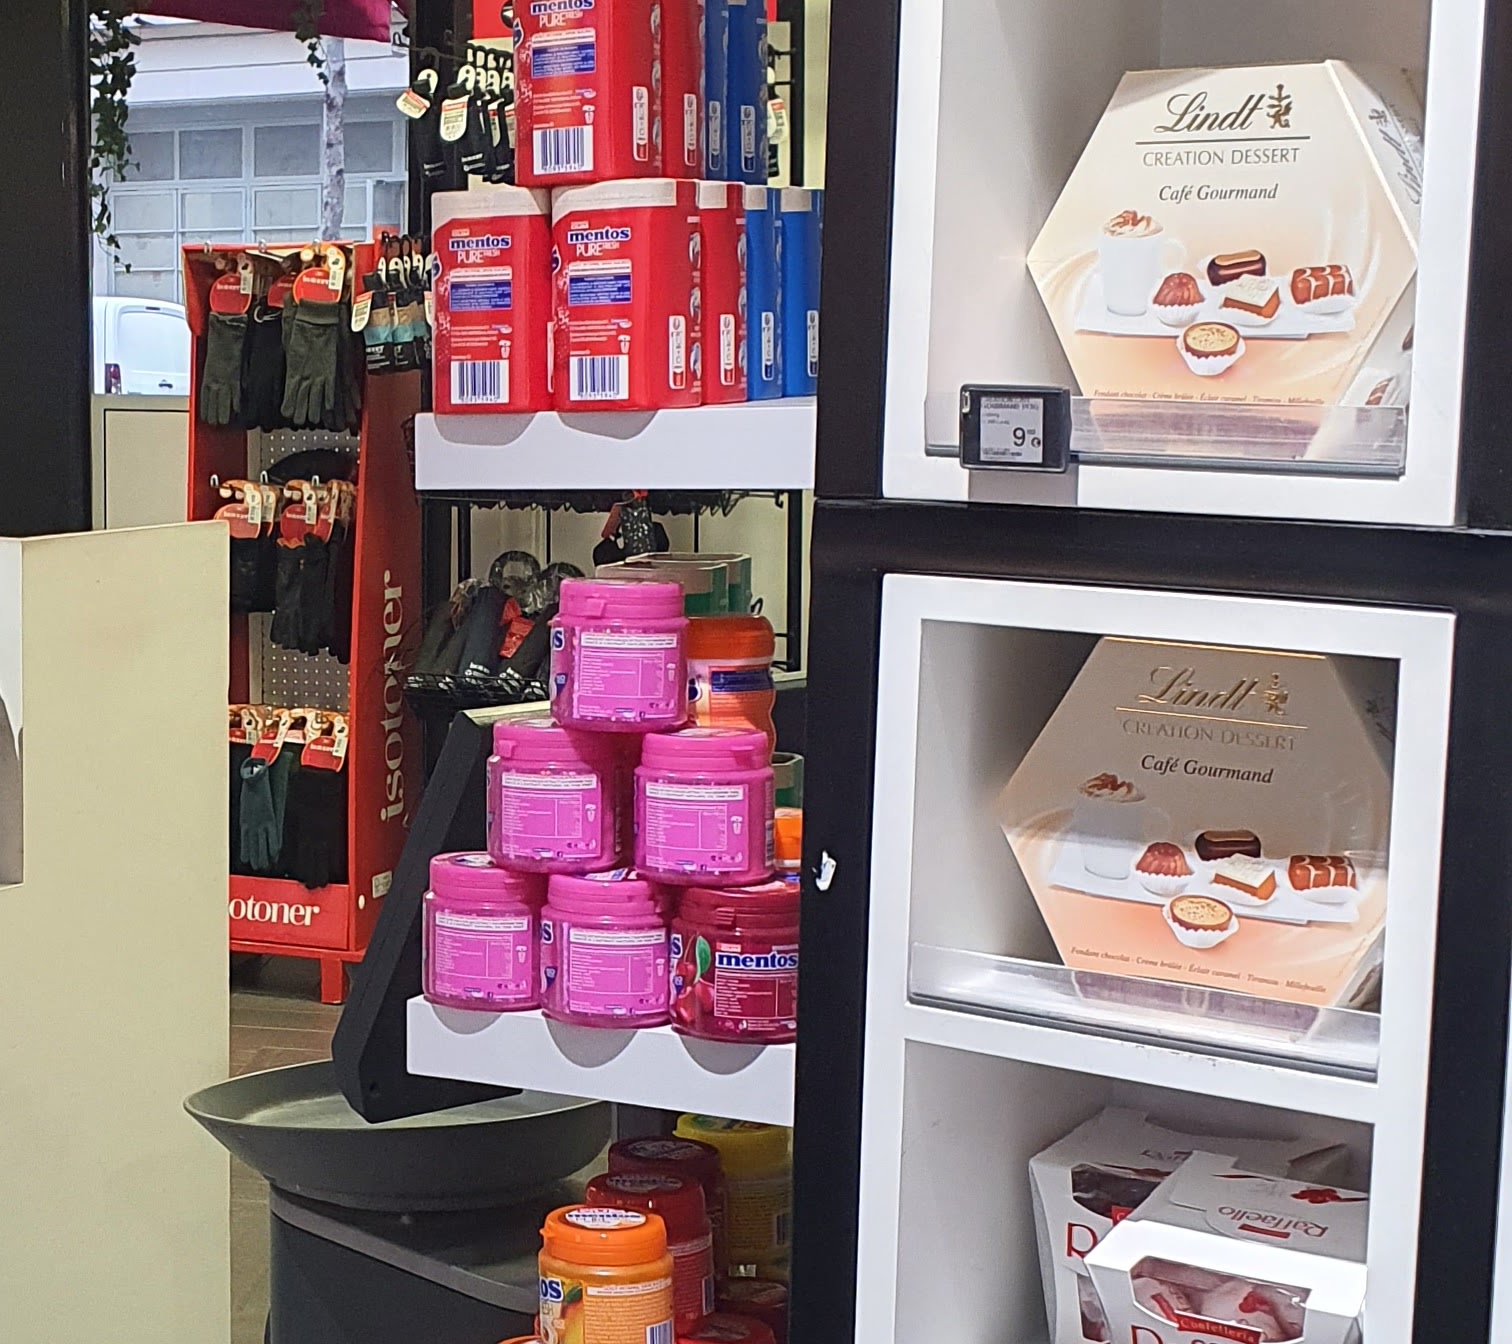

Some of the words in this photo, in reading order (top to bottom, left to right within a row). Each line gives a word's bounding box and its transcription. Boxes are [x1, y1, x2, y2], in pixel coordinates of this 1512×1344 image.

[539, 12, 565, 28] PURE
[1153, 91, 1265, 133] Lindt
[1143, 150, 1224, 167] CREATION
[1231, 148, 1300, 165] DESSERT
[1159, 185, 1193, 204] Café
[1197, 183, 1278, 200] Gourmand
[451, 234, 510, 249] mentos
[569, 227, 630, 242] mentos
[457, 249, 484, 263] PURE
[576, 242, 603, 256] PURE
[380, 570, 404, 822] isotoner
[1135, 666, 1259, 711] Lindt
[1122, 718, 1213, 741] CREATION
[1221, 730, 1296, 752] DESSERT
[1141, 754, 1180, 775] Café
[1184, 759, 1274, 784] Gourmand
[229, 895, 321, 926] otoner
[718, 951, 798, 969] mentos
[1218, 1205, 1328, 1238] Raffaello
